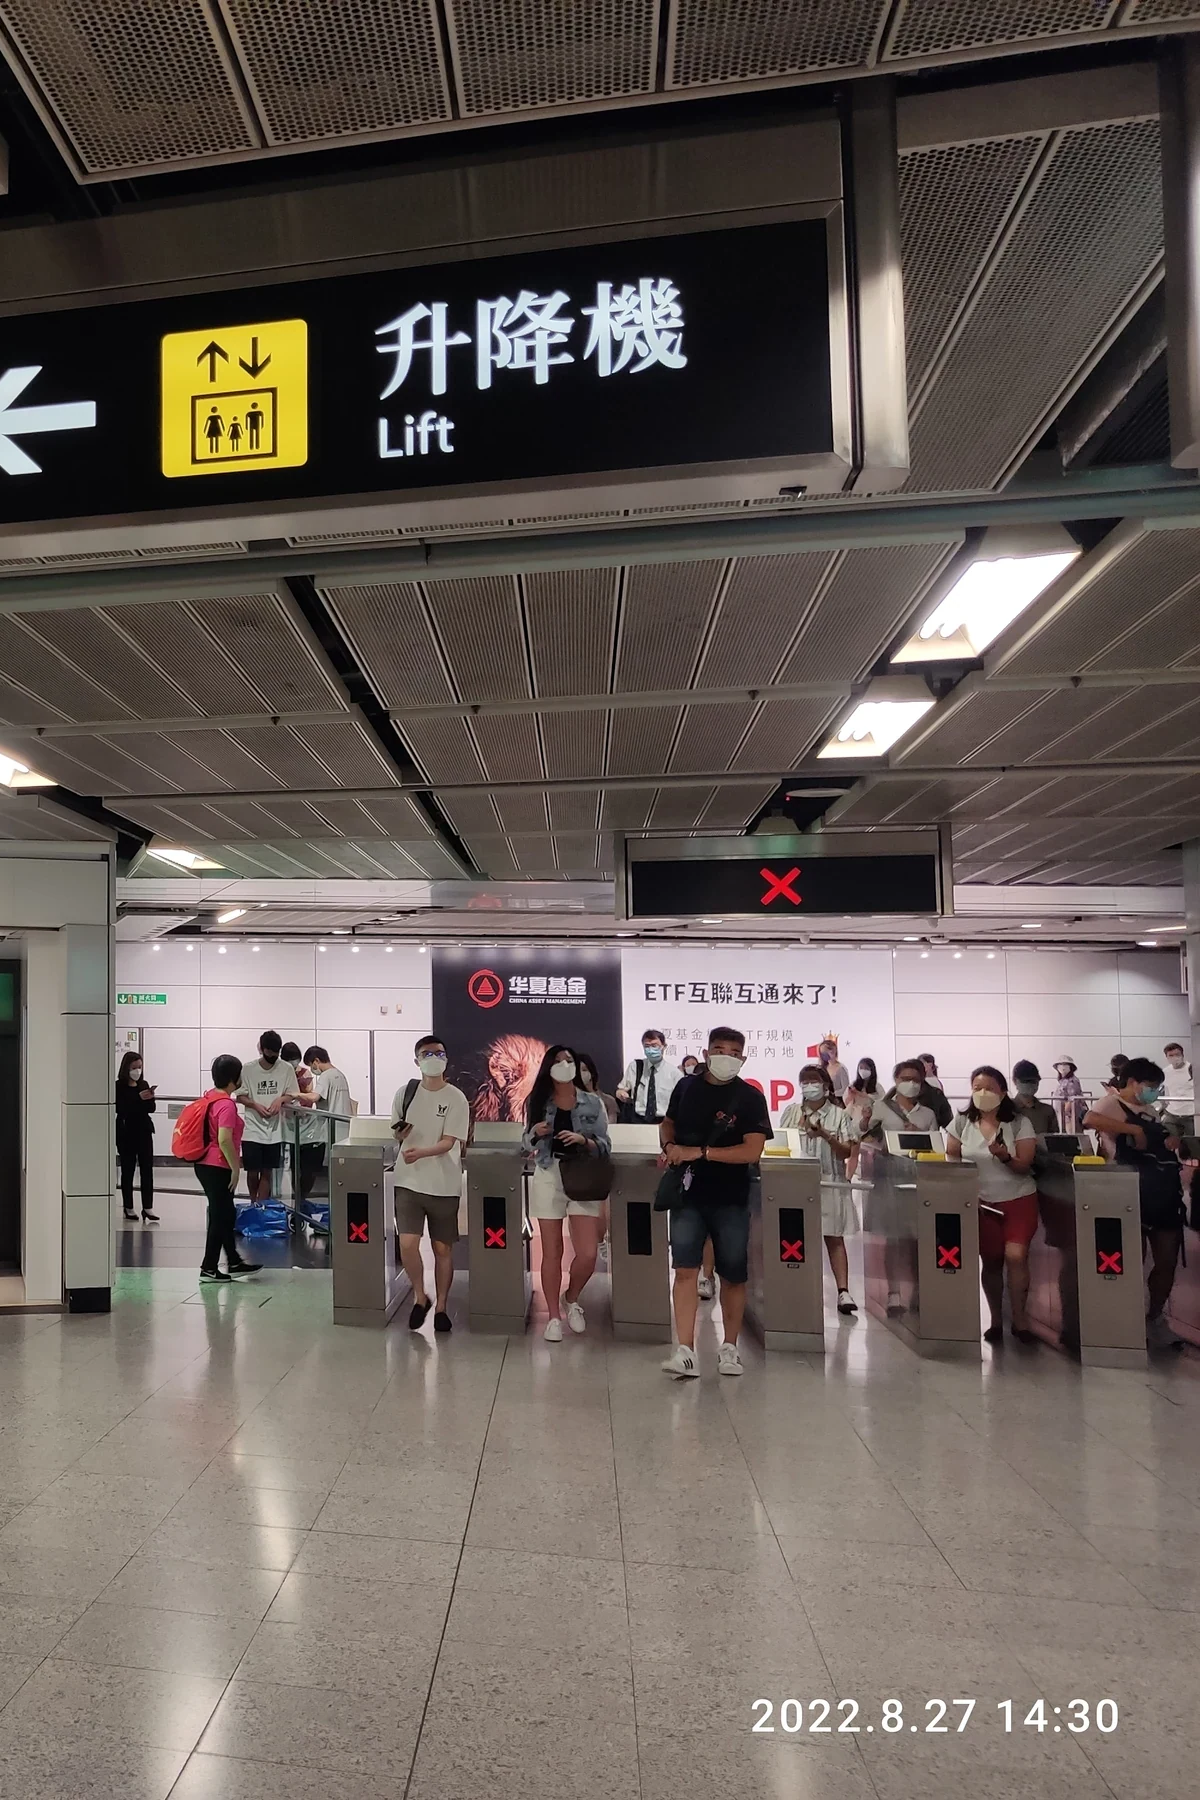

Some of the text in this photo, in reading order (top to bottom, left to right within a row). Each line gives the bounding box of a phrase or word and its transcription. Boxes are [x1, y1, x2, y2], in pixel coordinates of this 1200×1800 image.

[375, 276, 688, 400] 升降機
[377, 411, 455, 460] Lift
[508, 975, 587, 996] 华夏基金
[644, 982, 838, 1006] ETF互聯互通來了!
